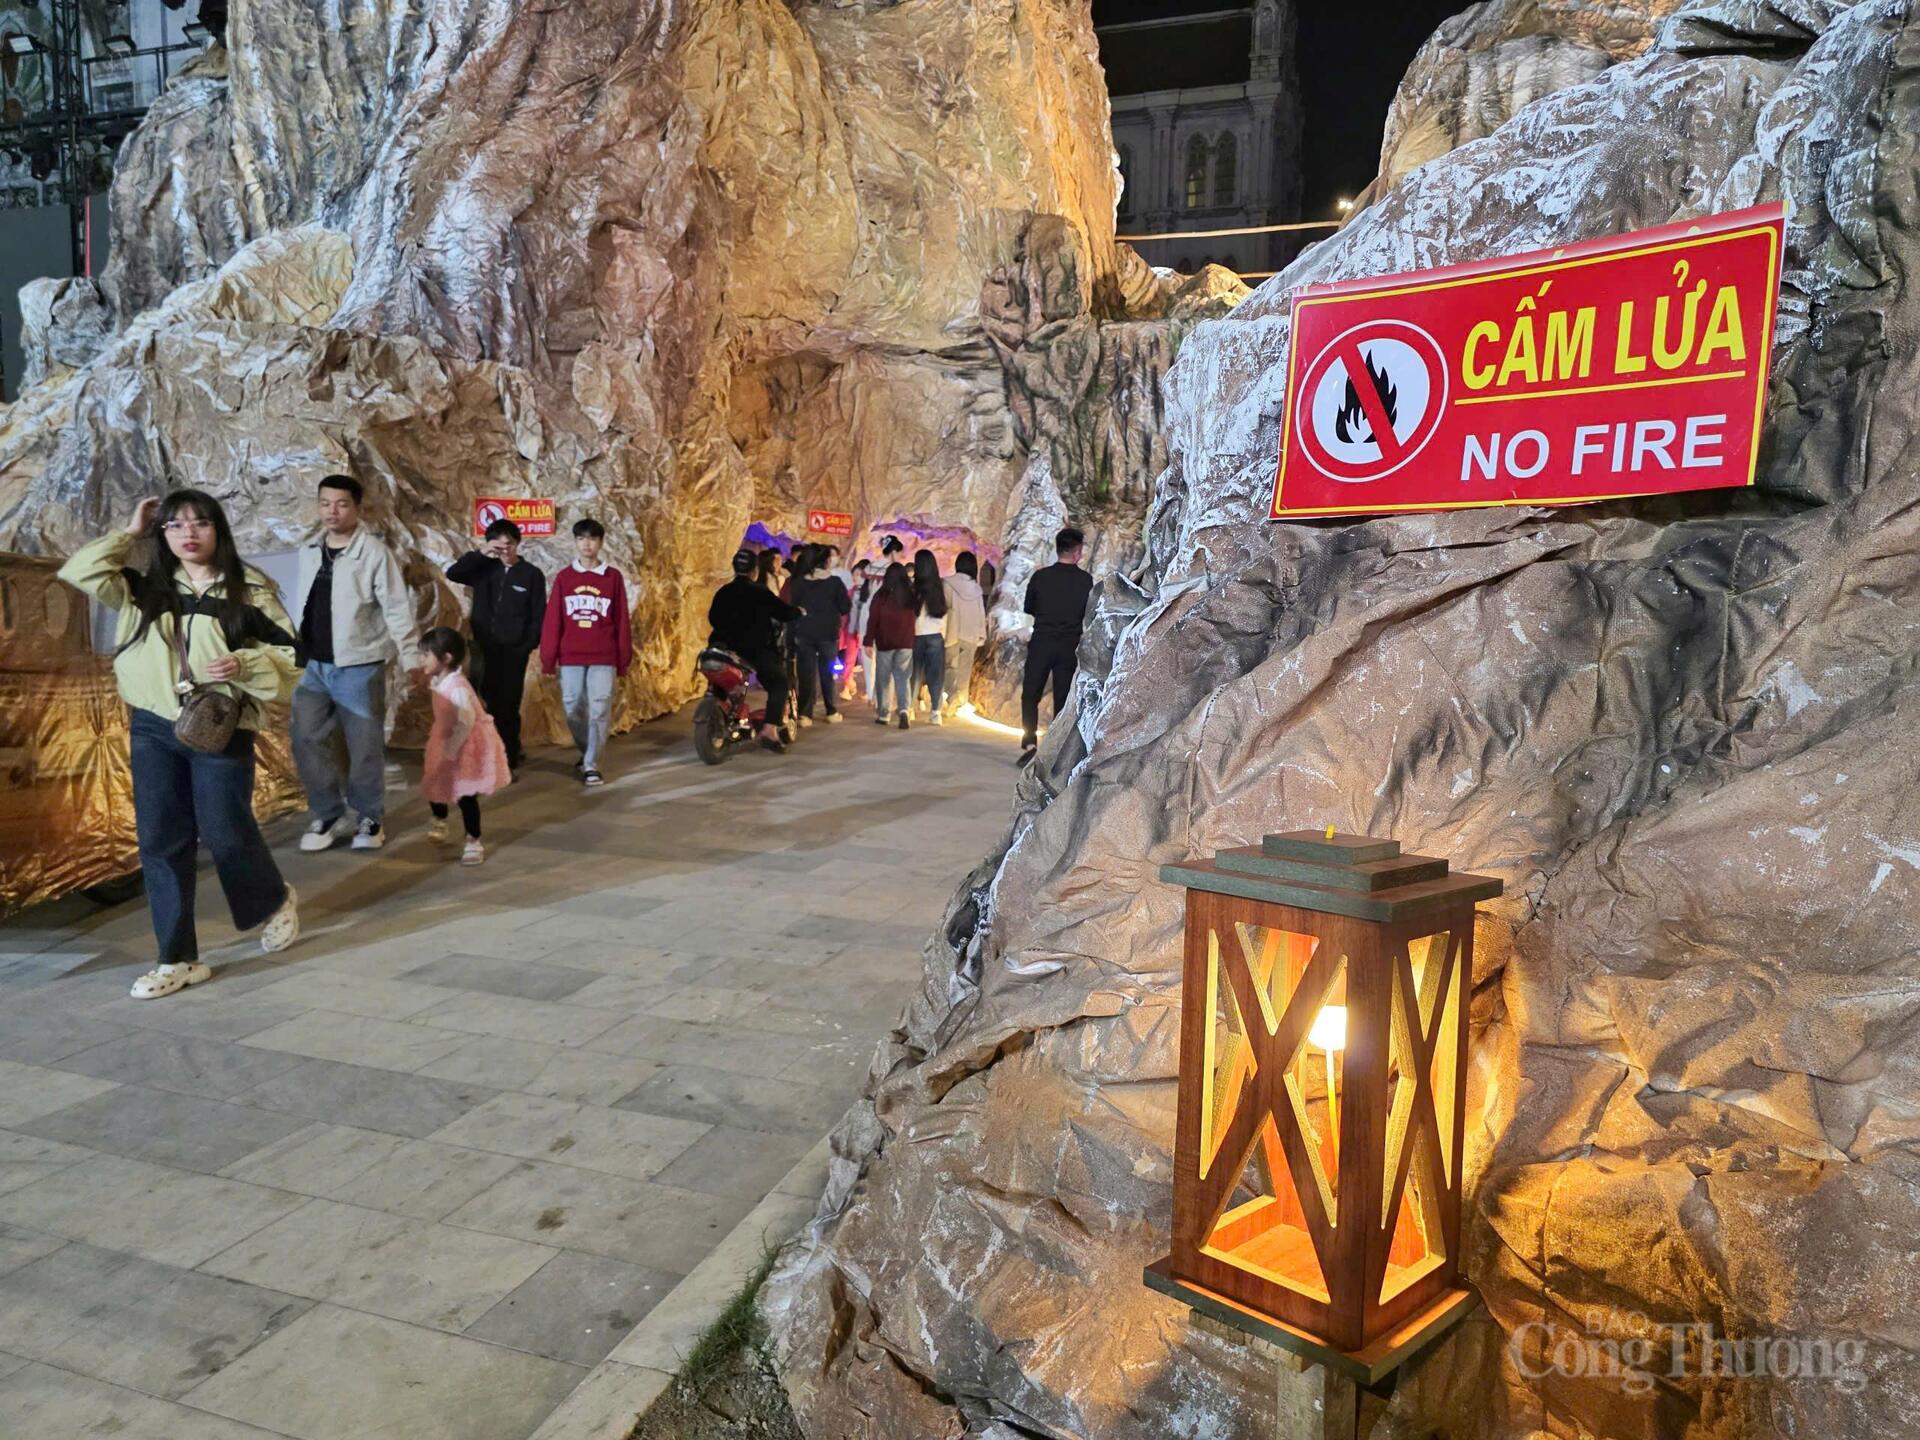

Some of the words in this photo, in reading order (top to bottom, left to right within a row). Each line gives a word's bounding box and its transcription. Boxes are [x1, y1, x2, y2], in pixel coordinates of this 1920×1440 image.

[1462, 280, 1597, 390] CẤM
[1615, 259, 1747, 375] LỬA
[1460, 429, 1550, 481] NO
[1571, 413, 1728, 476] FIRE
[507, 501, 530, 517] CẤM
[532, 501, 552, 517] LỬA
[528, 523, 551, 532] FIRE
